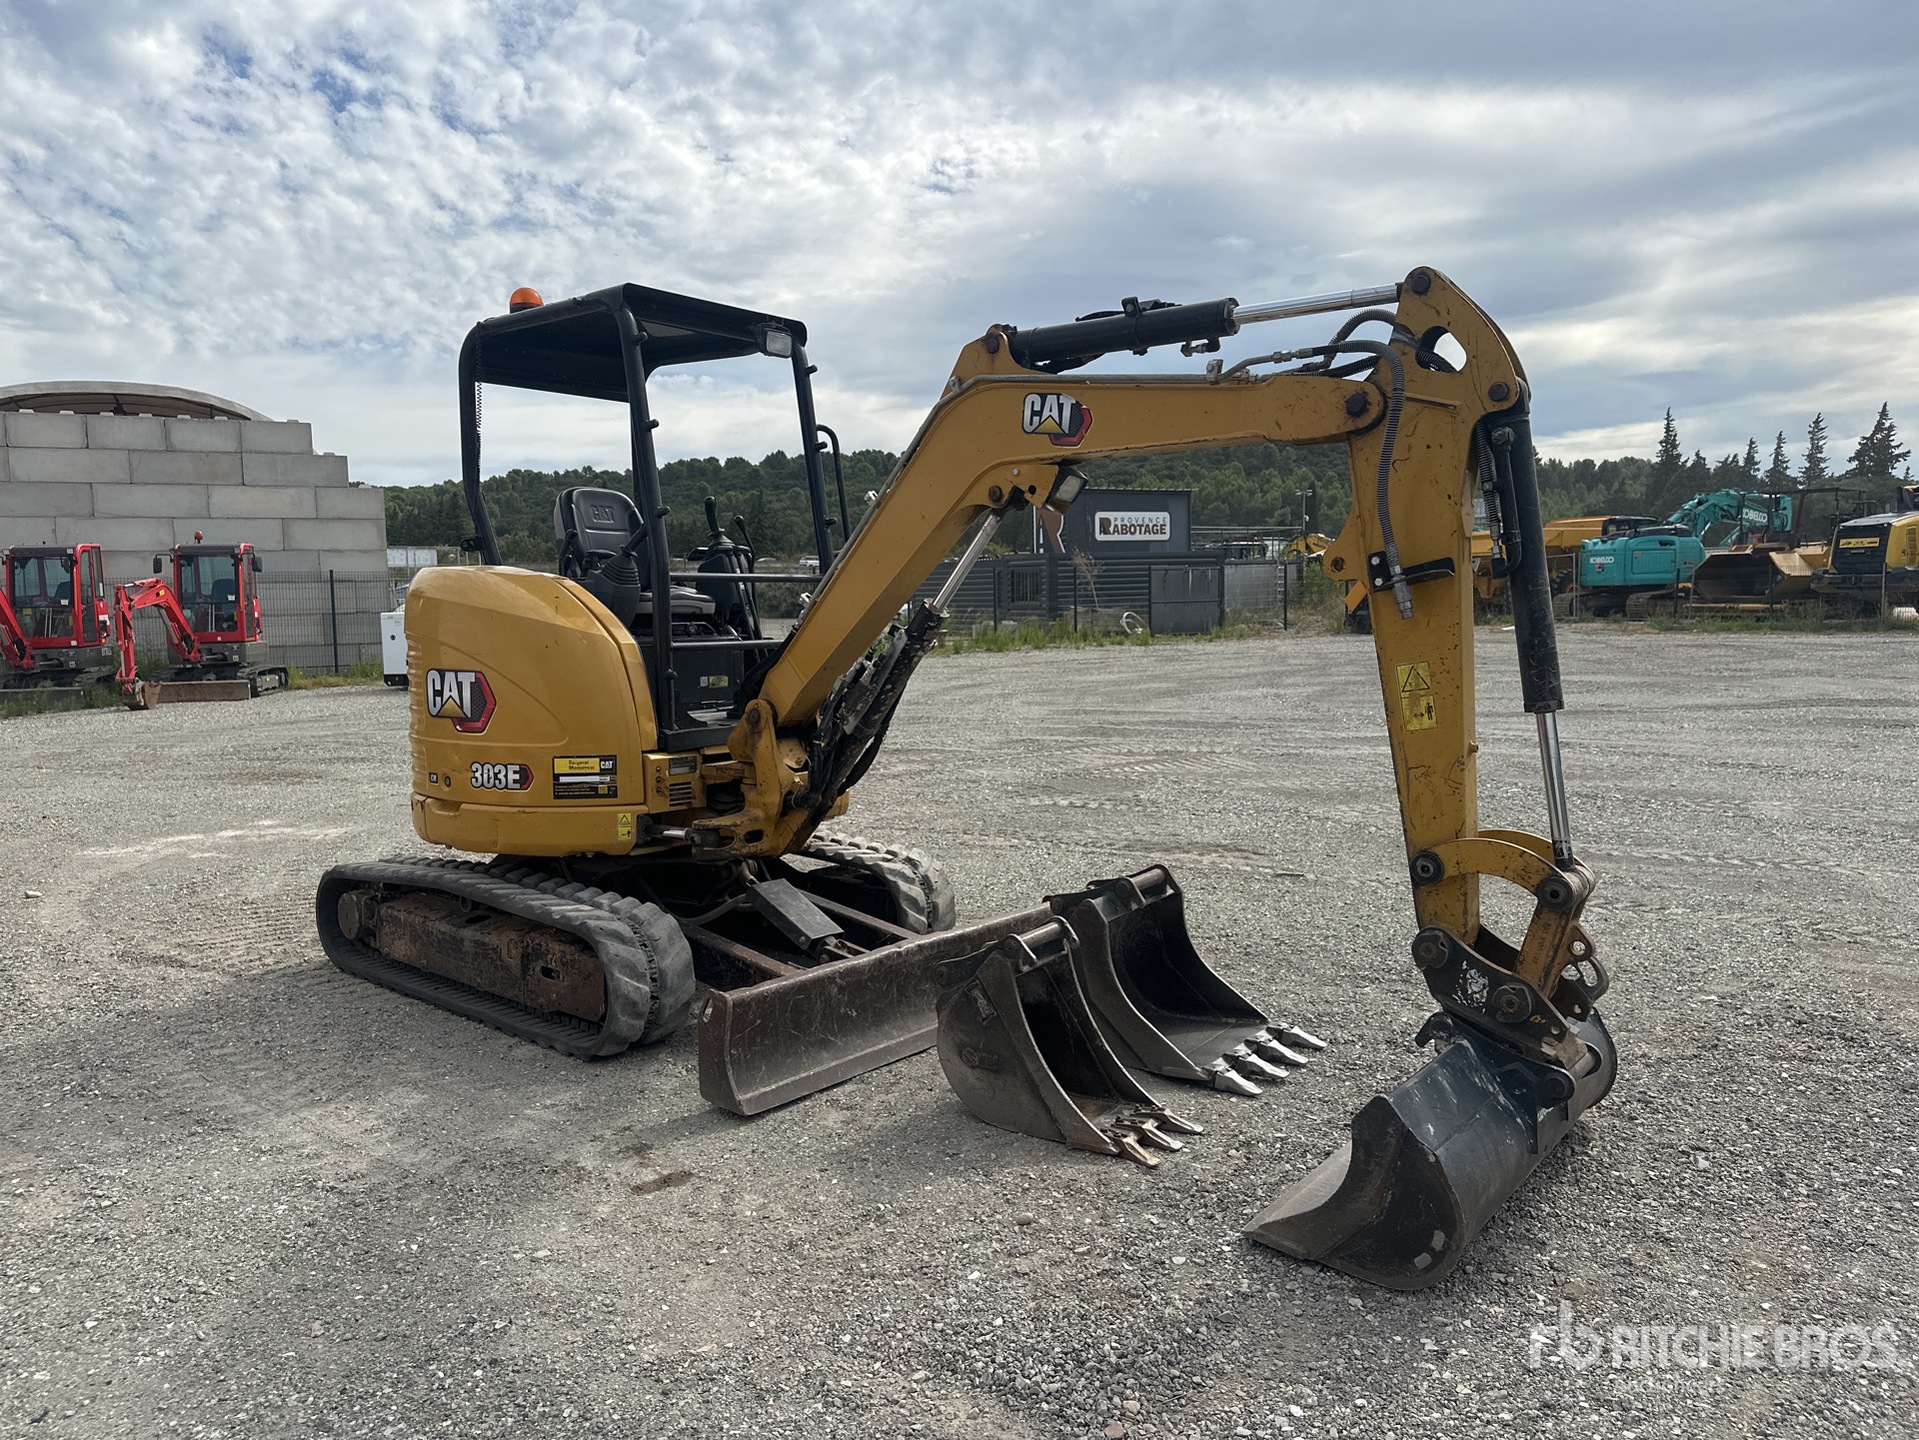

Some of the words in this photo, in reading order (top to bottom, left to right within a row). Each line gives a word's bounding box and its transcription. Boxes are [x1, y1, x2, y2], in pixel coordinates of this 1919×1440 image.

[1023, 394, 1076, 433] CAT
[591, 504, 615, 523] CAT
[1099, 517, 1167, 535] RABOTAGE
[427, 670, 475, 718] CAT
[471, 762, 520, 789] 303E
[600, 761, 613, 769] CAT
